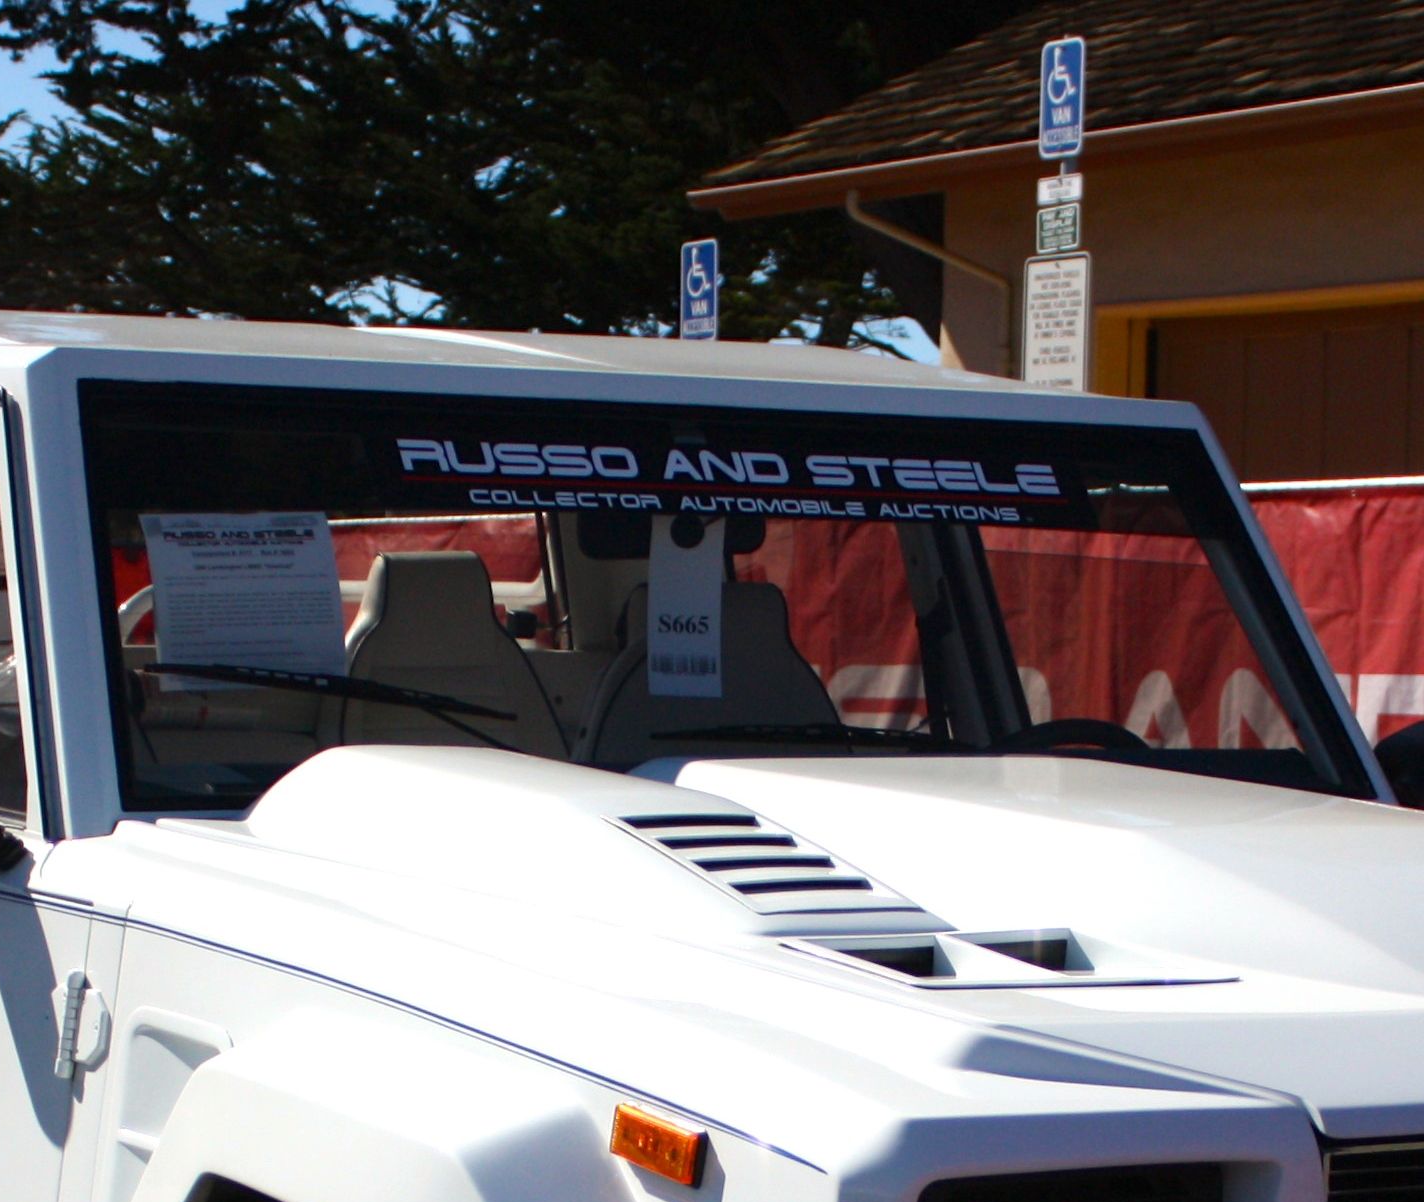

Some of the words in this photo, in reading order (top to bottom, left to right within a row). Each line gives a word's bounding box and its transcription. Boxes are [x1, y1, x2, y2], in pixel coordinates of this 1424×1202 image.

[1051, 105, 1072, 126] VAN
[690, 298, 708, 317] VAN
[396, 438, 639, 478] RUSSO
[663, 449, 790, 484] AND
[805, 455, 1061, 495] STEELE
[469, 489, 662, 509] COLLECTOR
[680, 496, 866, 516] AUTOMOBILE
[880, 503, 1020, 521] AUCTIONS
[658, 614, 709, 635] S665
